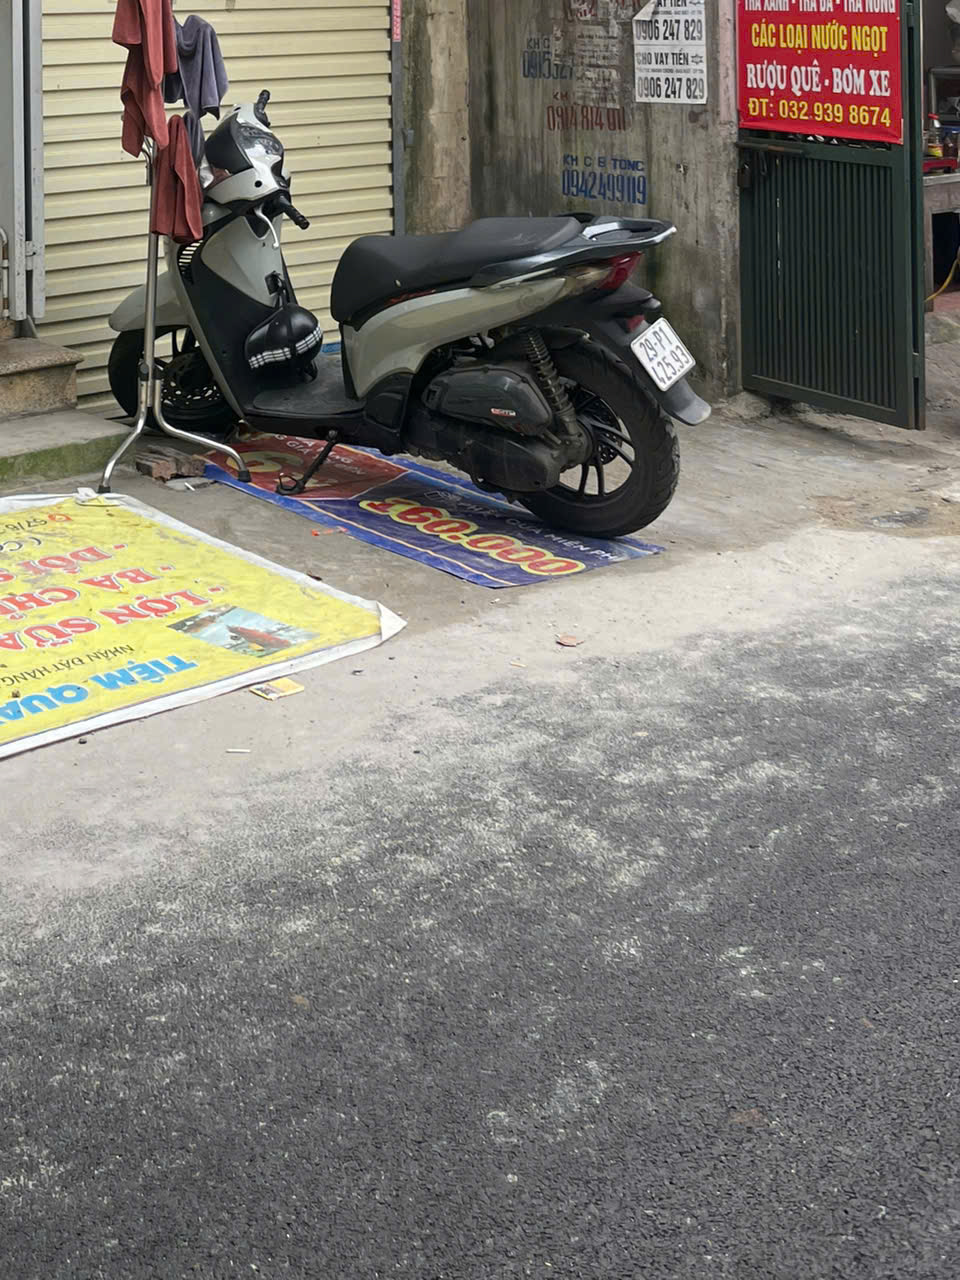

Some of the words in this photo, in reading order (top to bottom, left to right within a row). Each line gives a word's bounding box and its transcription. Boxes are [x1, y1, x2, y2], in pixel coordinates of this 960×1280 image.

[635, 19, 660, 41] 0906
[662, 19, 681, 41] 247
[684, 19, 704, 41] 829
[751, 18, 776, 48] CÁC
[779, 23, 808, 55] LOẠI
[811, 19, 848, 51] NƯỚC
[851, 25, 889, 58] NGỌT
[654, 52, 670, 66] VAY
[637, 76, 662, 99] 0906
[664, 76, 683, 99] 247
[685, 76, 705, 100] 829
[746, 59, 788, 97] RƯỢU
[791, 58, 822, 97] QUÊ
[832, 63, 866, 96] BƠM
[869, 70, 891, 97] XE
[748, 97, 775, 118] ĐT:
[848, 104, 892, 128] 8674
[639, 326, 673, 362] 29-P1
[651, 344, 690, 385] 425.93
[89, 590, 209, 625] LỢN
[90, 655, 196, 690] TIỆM
